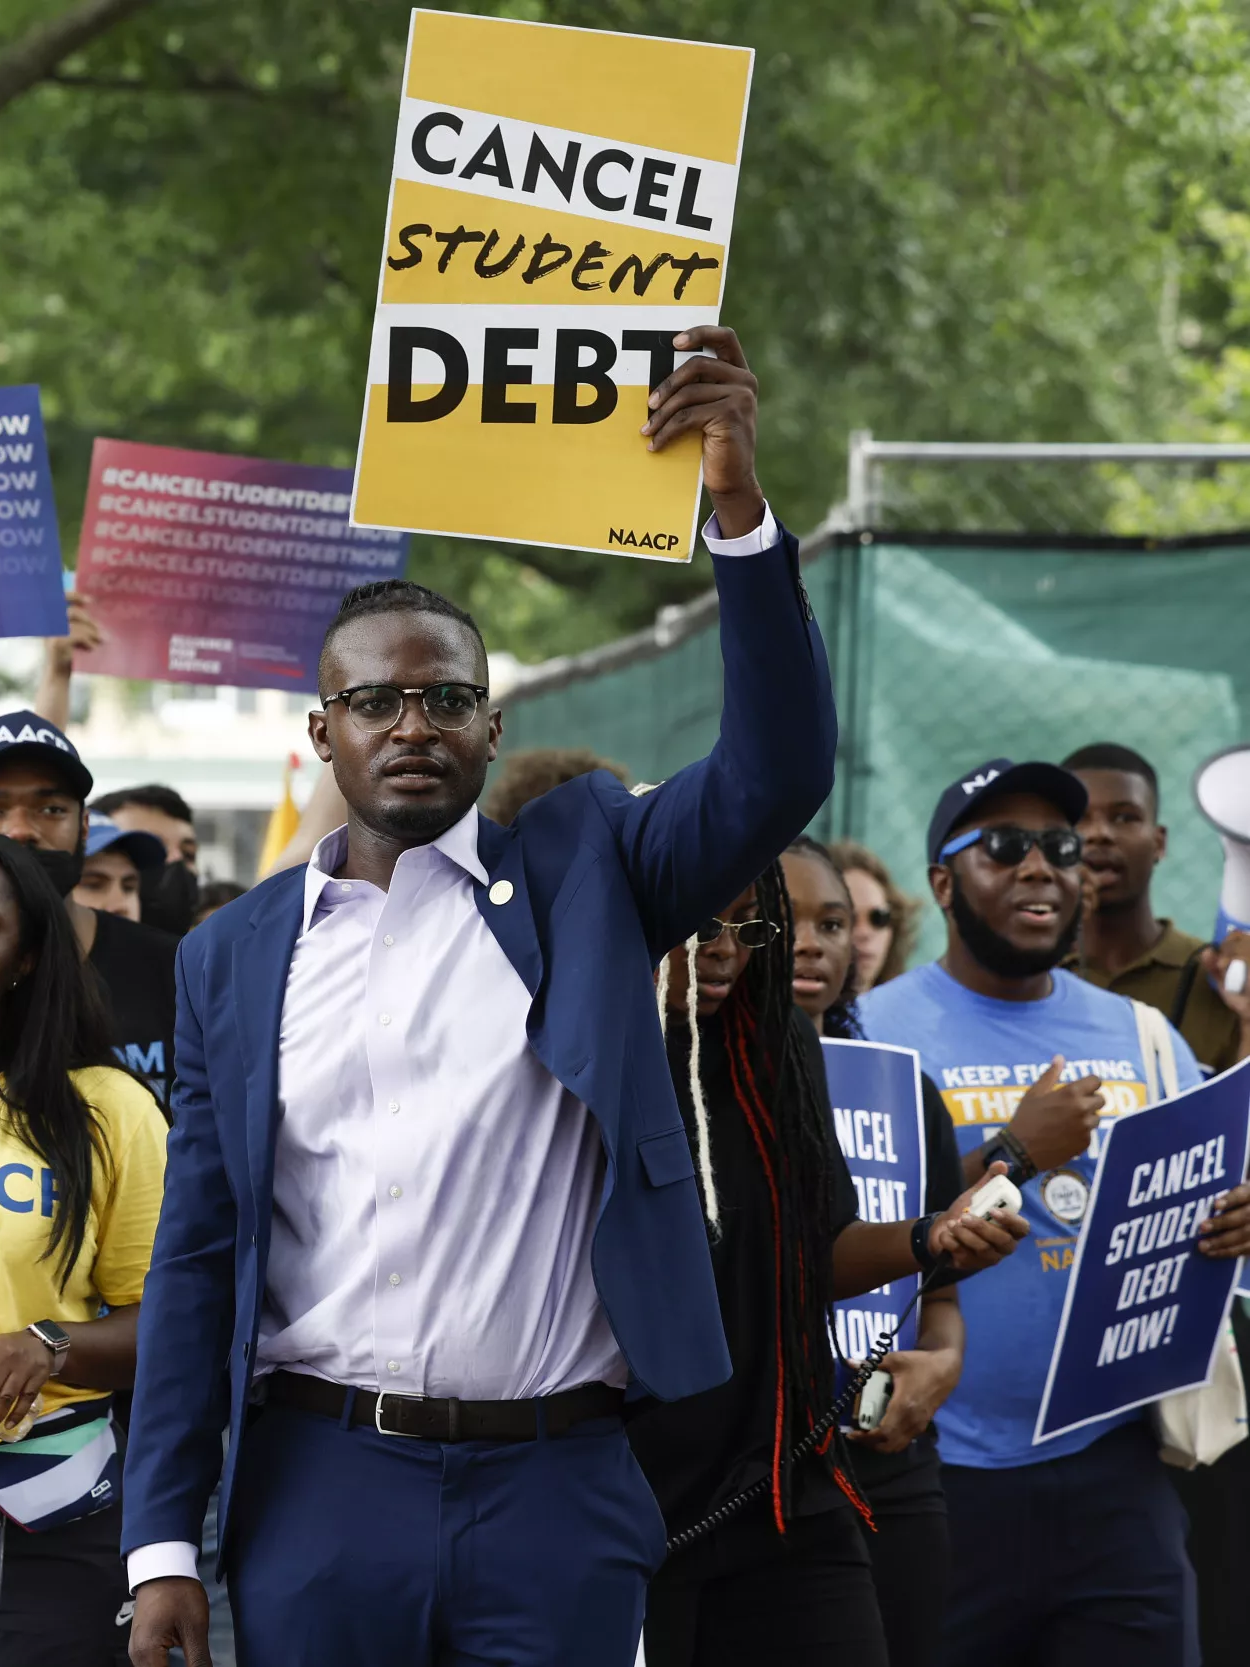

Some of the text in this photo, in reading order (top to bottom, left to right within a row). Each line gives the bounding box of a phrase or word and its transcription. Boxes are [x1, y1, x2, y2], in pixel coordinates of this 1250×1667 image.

[411, 111, 713, 231] CANCEL
[388, 223, 720, 299] STUDENT
[387, 326, 704, 424] DEBT
[102, 467, 352, 514] #CANCELSTUDENTDEB
[608, 528, 679, 552] NAACP
[942, 1065, 1010, 1088] KEEP
[833, 1108, 898, 1164] NCEL
[851, 1175, 907, 1223] DENT
[1128, 1134, 1226, 1208] CANCEL
[1116, 1252, 1191, 1311] DEBT
[1096, 1304, 1180, 1367] NOW!
